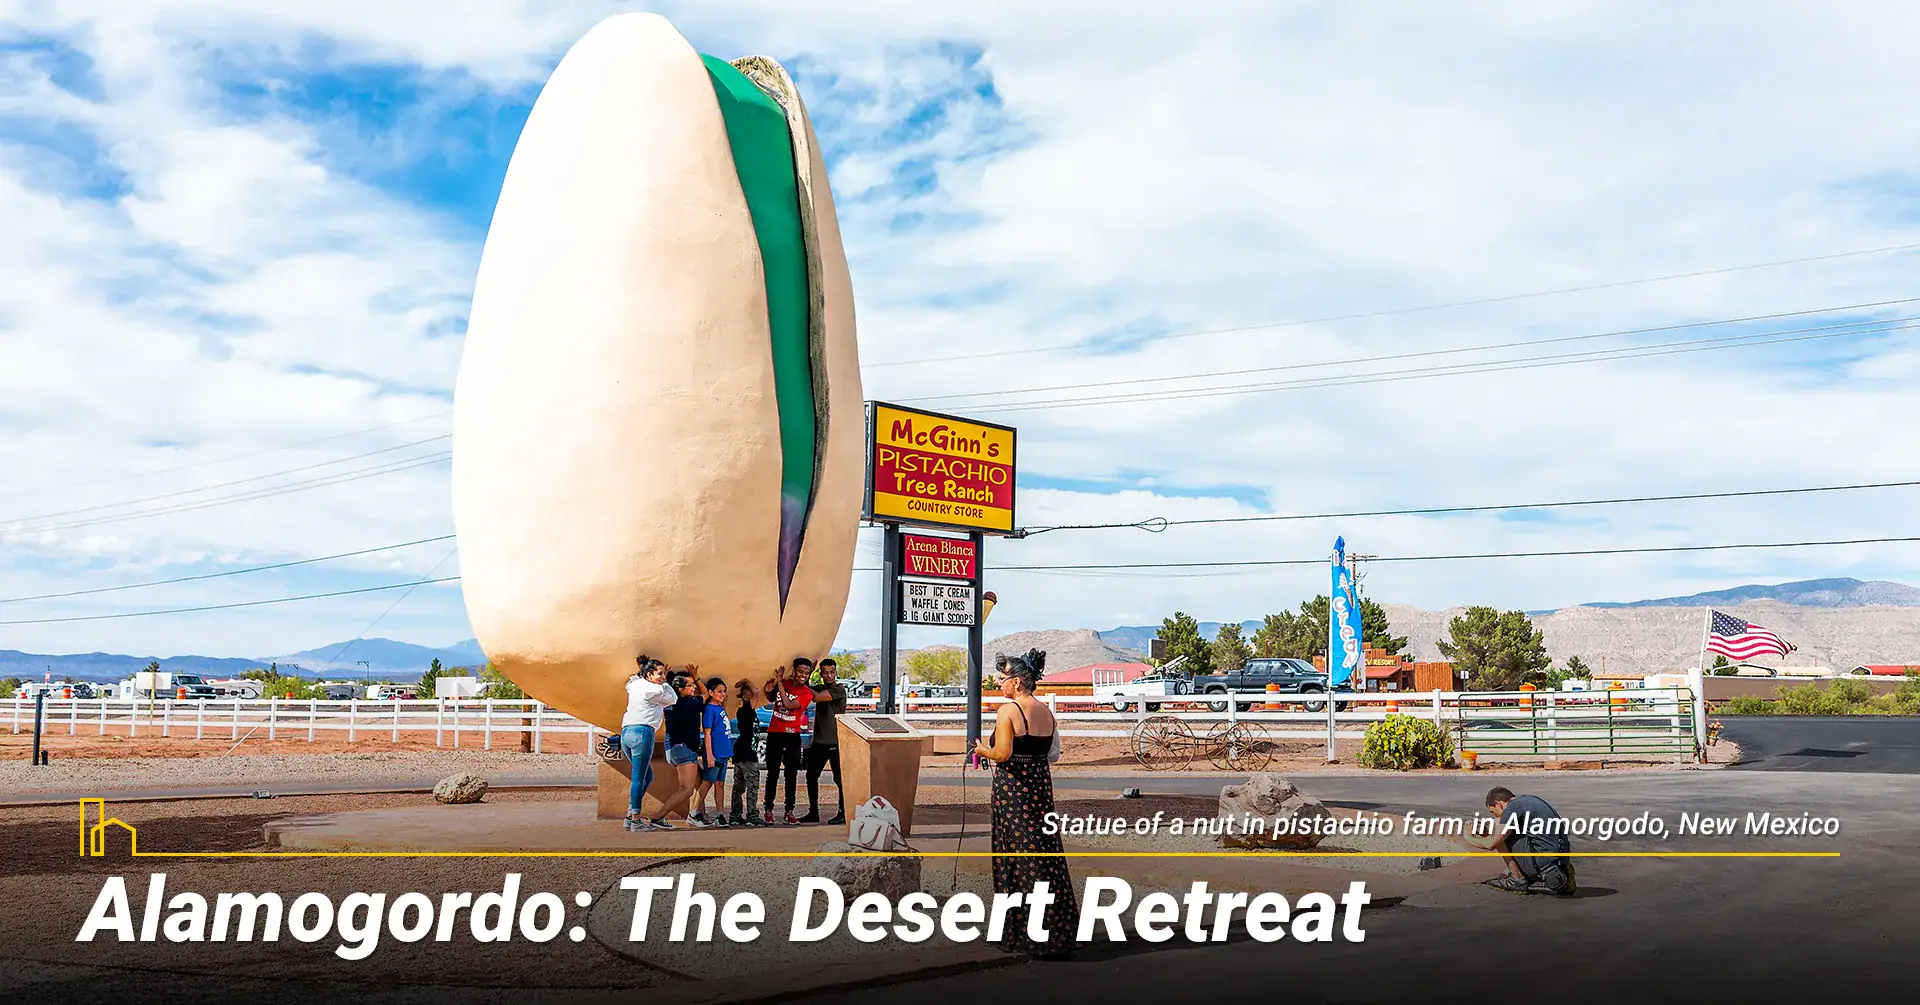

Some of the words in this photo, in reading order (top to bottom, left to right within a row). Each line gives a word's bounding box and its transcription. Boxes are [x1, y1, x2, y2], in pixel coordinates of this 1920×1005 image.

[891, 418, 1000, 458] McGinn's
[879, 448, 1007, 485] PISTACHIO
[893, 472, 938, 496] Tree
[943, 479, 994, 504] Ranch
[907, 499, 952, 515] COUNTRY
[953, 505, 983, 519] STORE
[906, 537, 938, 553] Arena
[940, 541, 974, 557] Blanca
[910, 554, 970, 576] WINERY
[909, 584, 928, 596] BEST
[933, 586, 944, 597] ICE
[947, 587, 970, 599] CREAM
[911, 597, 939, 610] WAFFLE
[943, 599, 965, 611] CONES
[922, 611, 945, 623] GIANT
[947, 612, 974, 625] SCOOPS
